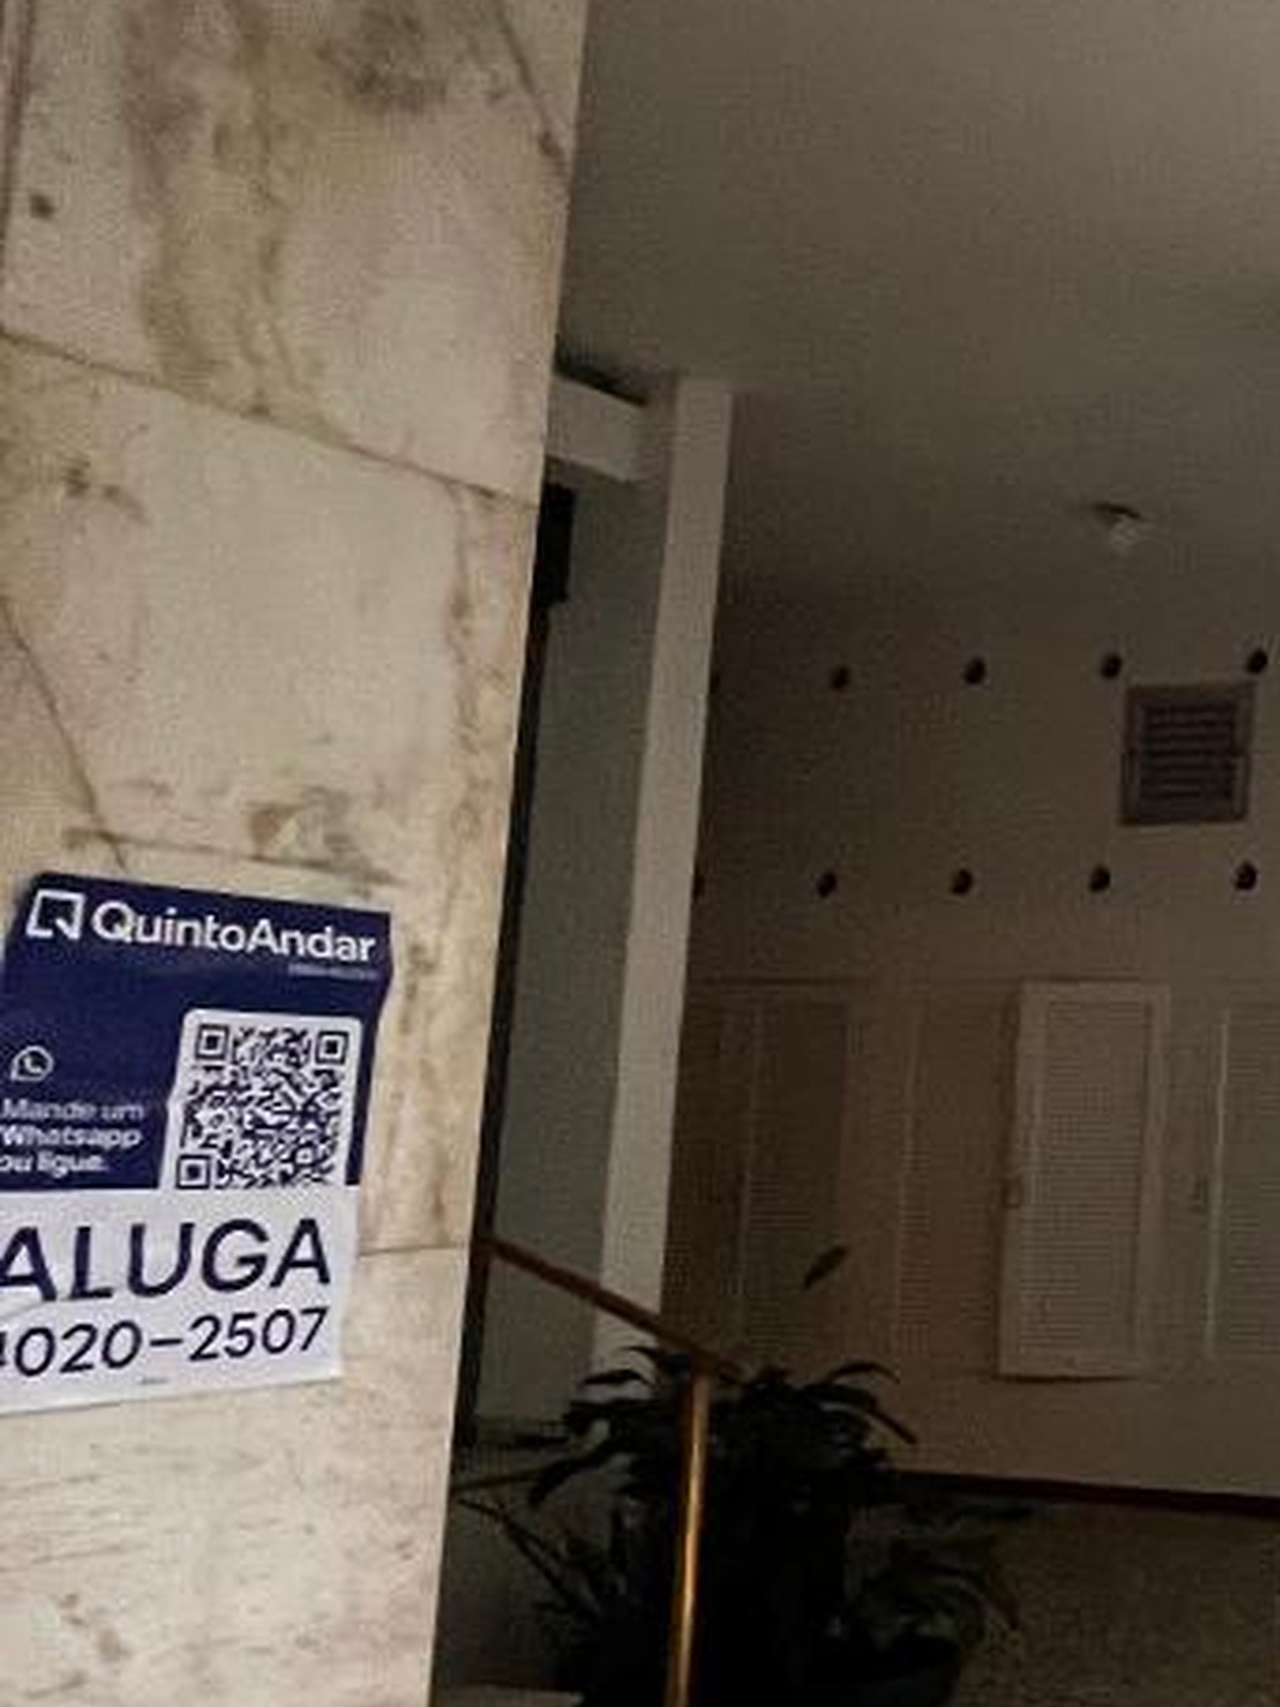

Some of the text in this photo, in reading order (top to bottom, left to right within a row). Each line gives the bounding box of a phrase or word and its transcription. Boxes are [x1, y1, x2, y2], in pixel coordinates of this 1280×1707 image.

[91, 899, 377, 962] QuintoAndar
[0, 1217, 331, 1302] ALUGA
[0, 1306, 328, 1378] 020-2507
